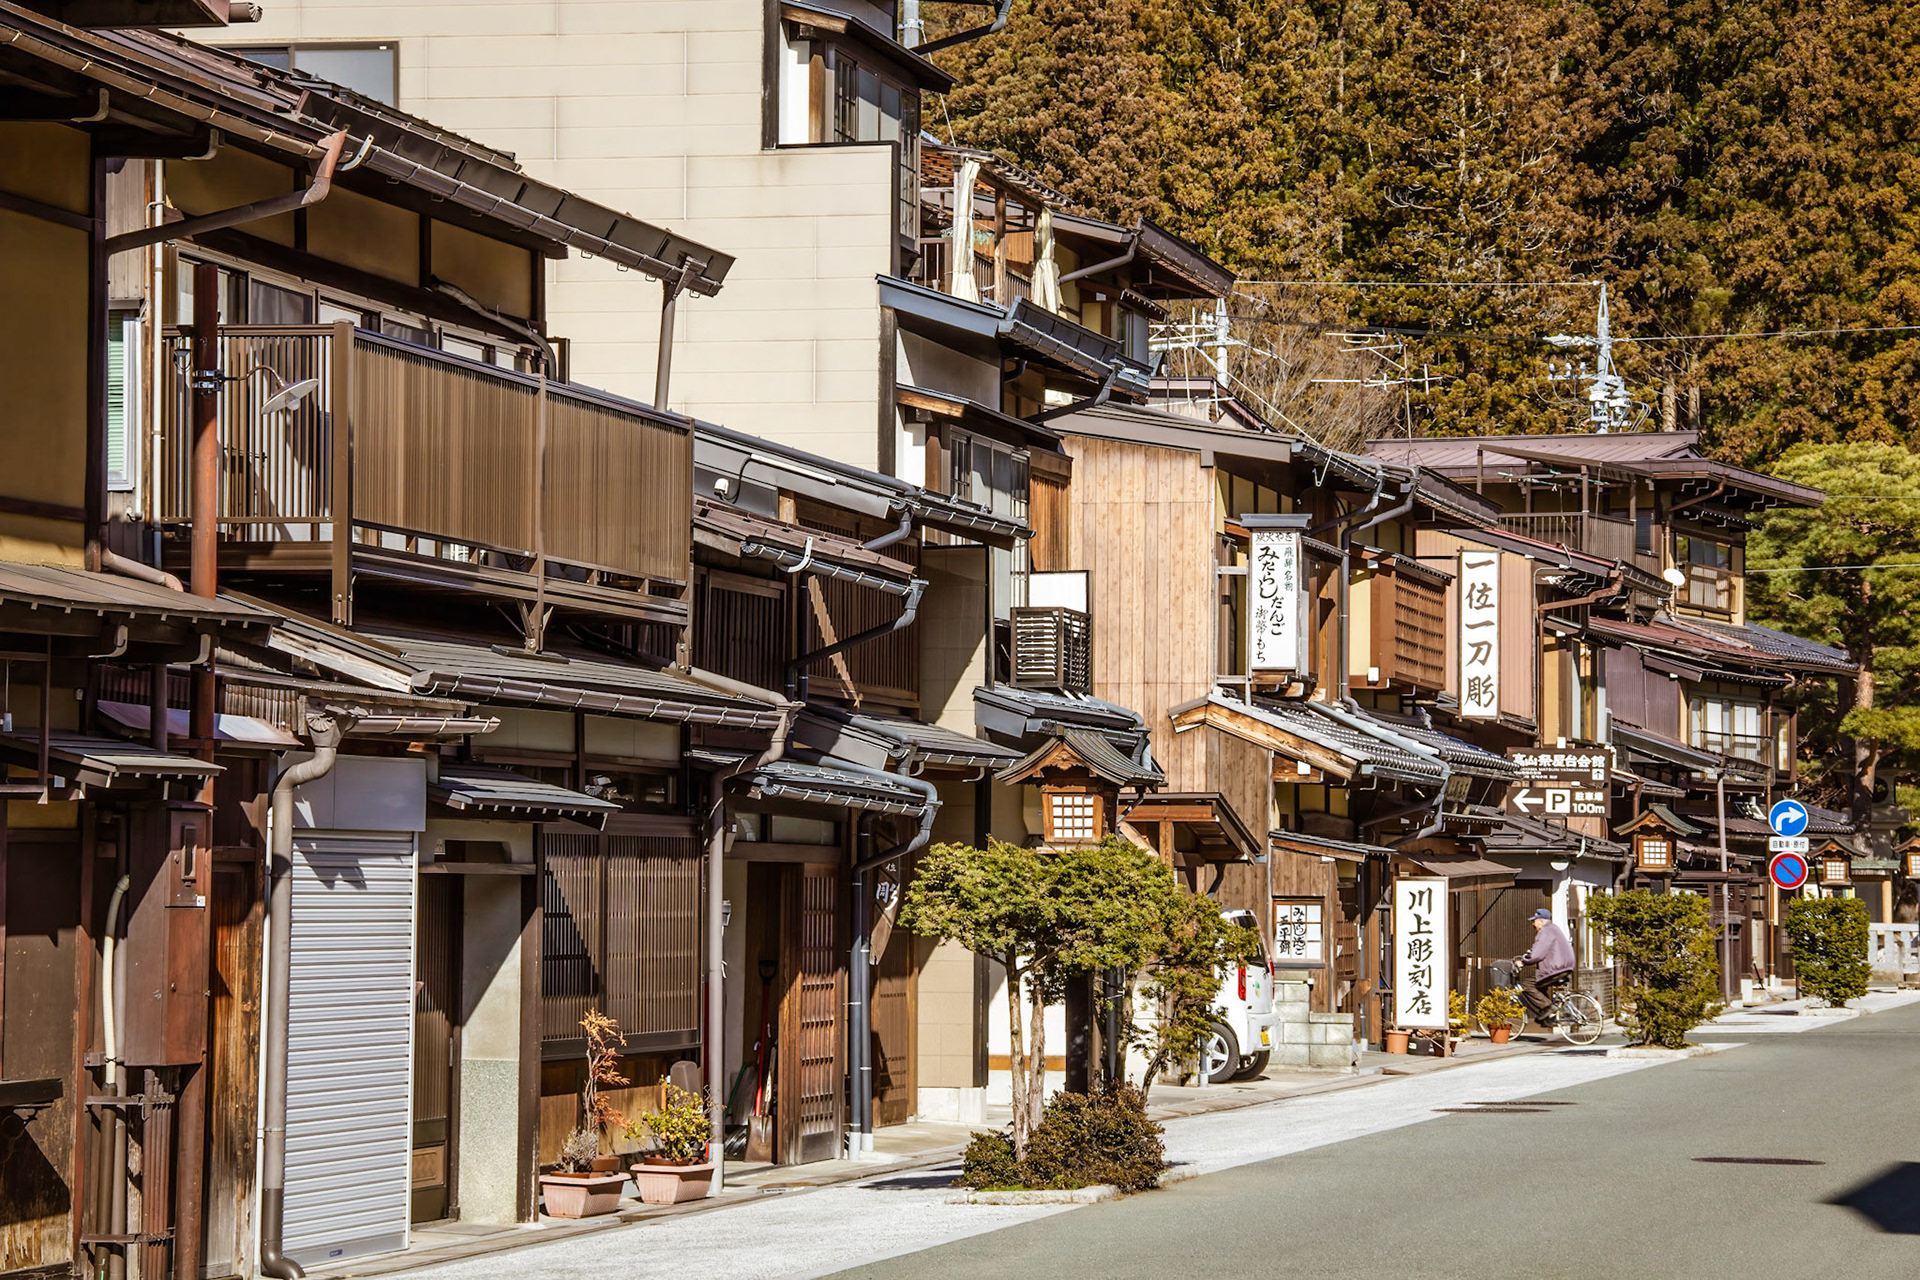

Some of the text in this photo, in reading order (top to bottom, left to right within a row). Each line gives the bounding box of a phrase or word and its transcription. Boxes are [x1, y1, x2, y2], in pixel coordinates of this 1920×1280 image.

[1258, 546, 1285, 635] みたらしだんご
[1465, 559, 1495, 708] 一位一刀彫
[1512, 753, 1605, 767] 高山祭屋台会館
[1552, 793, 1566, 810] P
[1572, 803, 1605, 813] 100m
[1405, 887, 1433, 1015] 川上彫刻店
